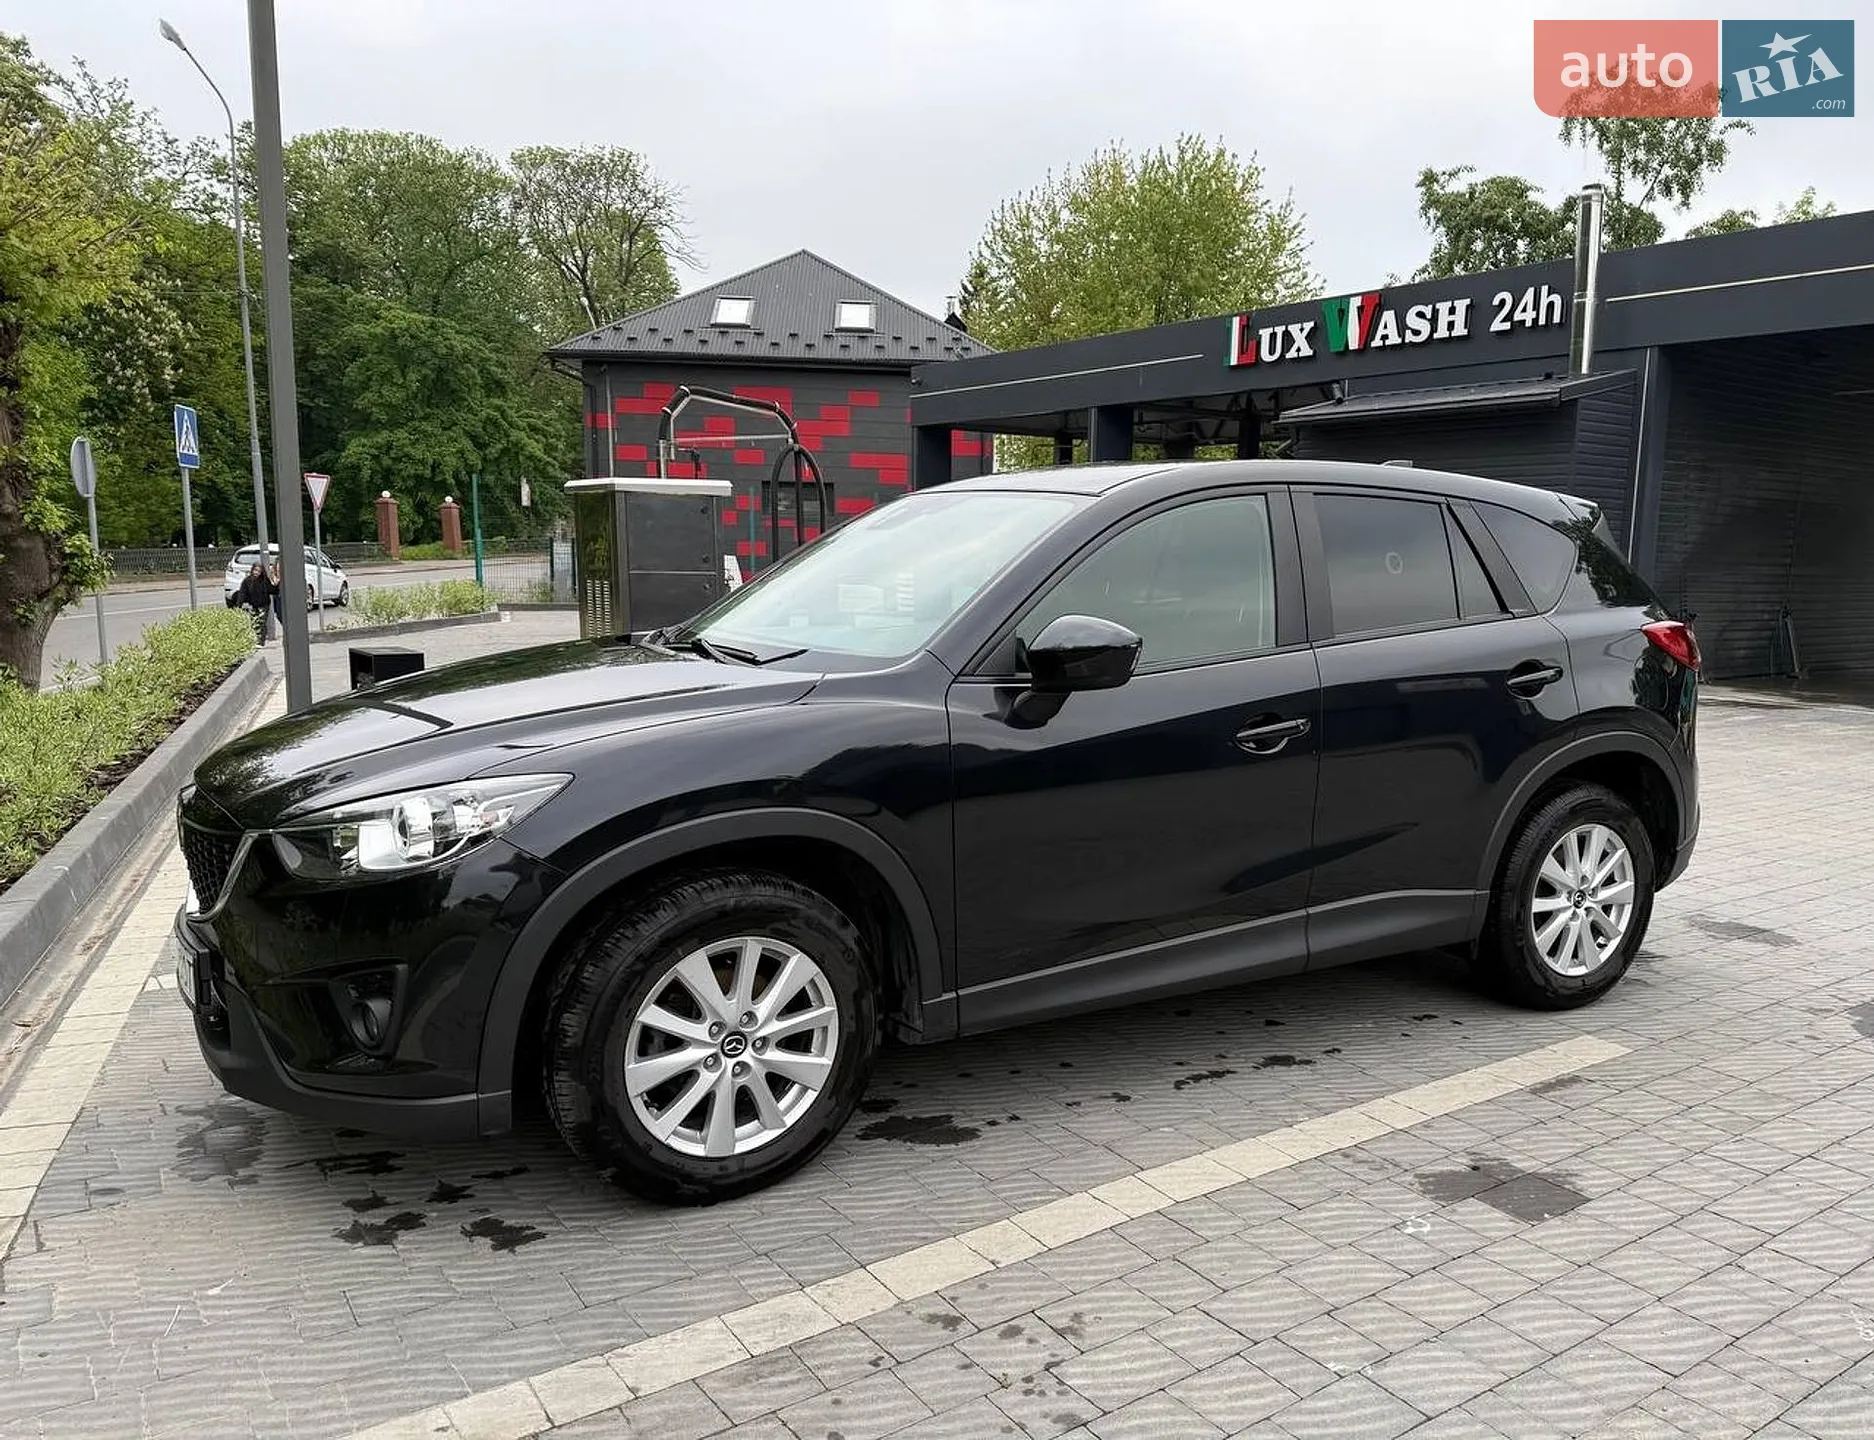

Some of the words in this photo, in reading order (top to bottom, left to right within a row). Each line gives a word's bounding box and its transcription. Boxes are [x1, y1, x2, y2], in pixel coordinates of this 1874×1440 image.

[1224, 313, 1316, 366] LUX
[1322, 292, 1471, 352] WASH
[1489, 285, 1563, 332] 24h
